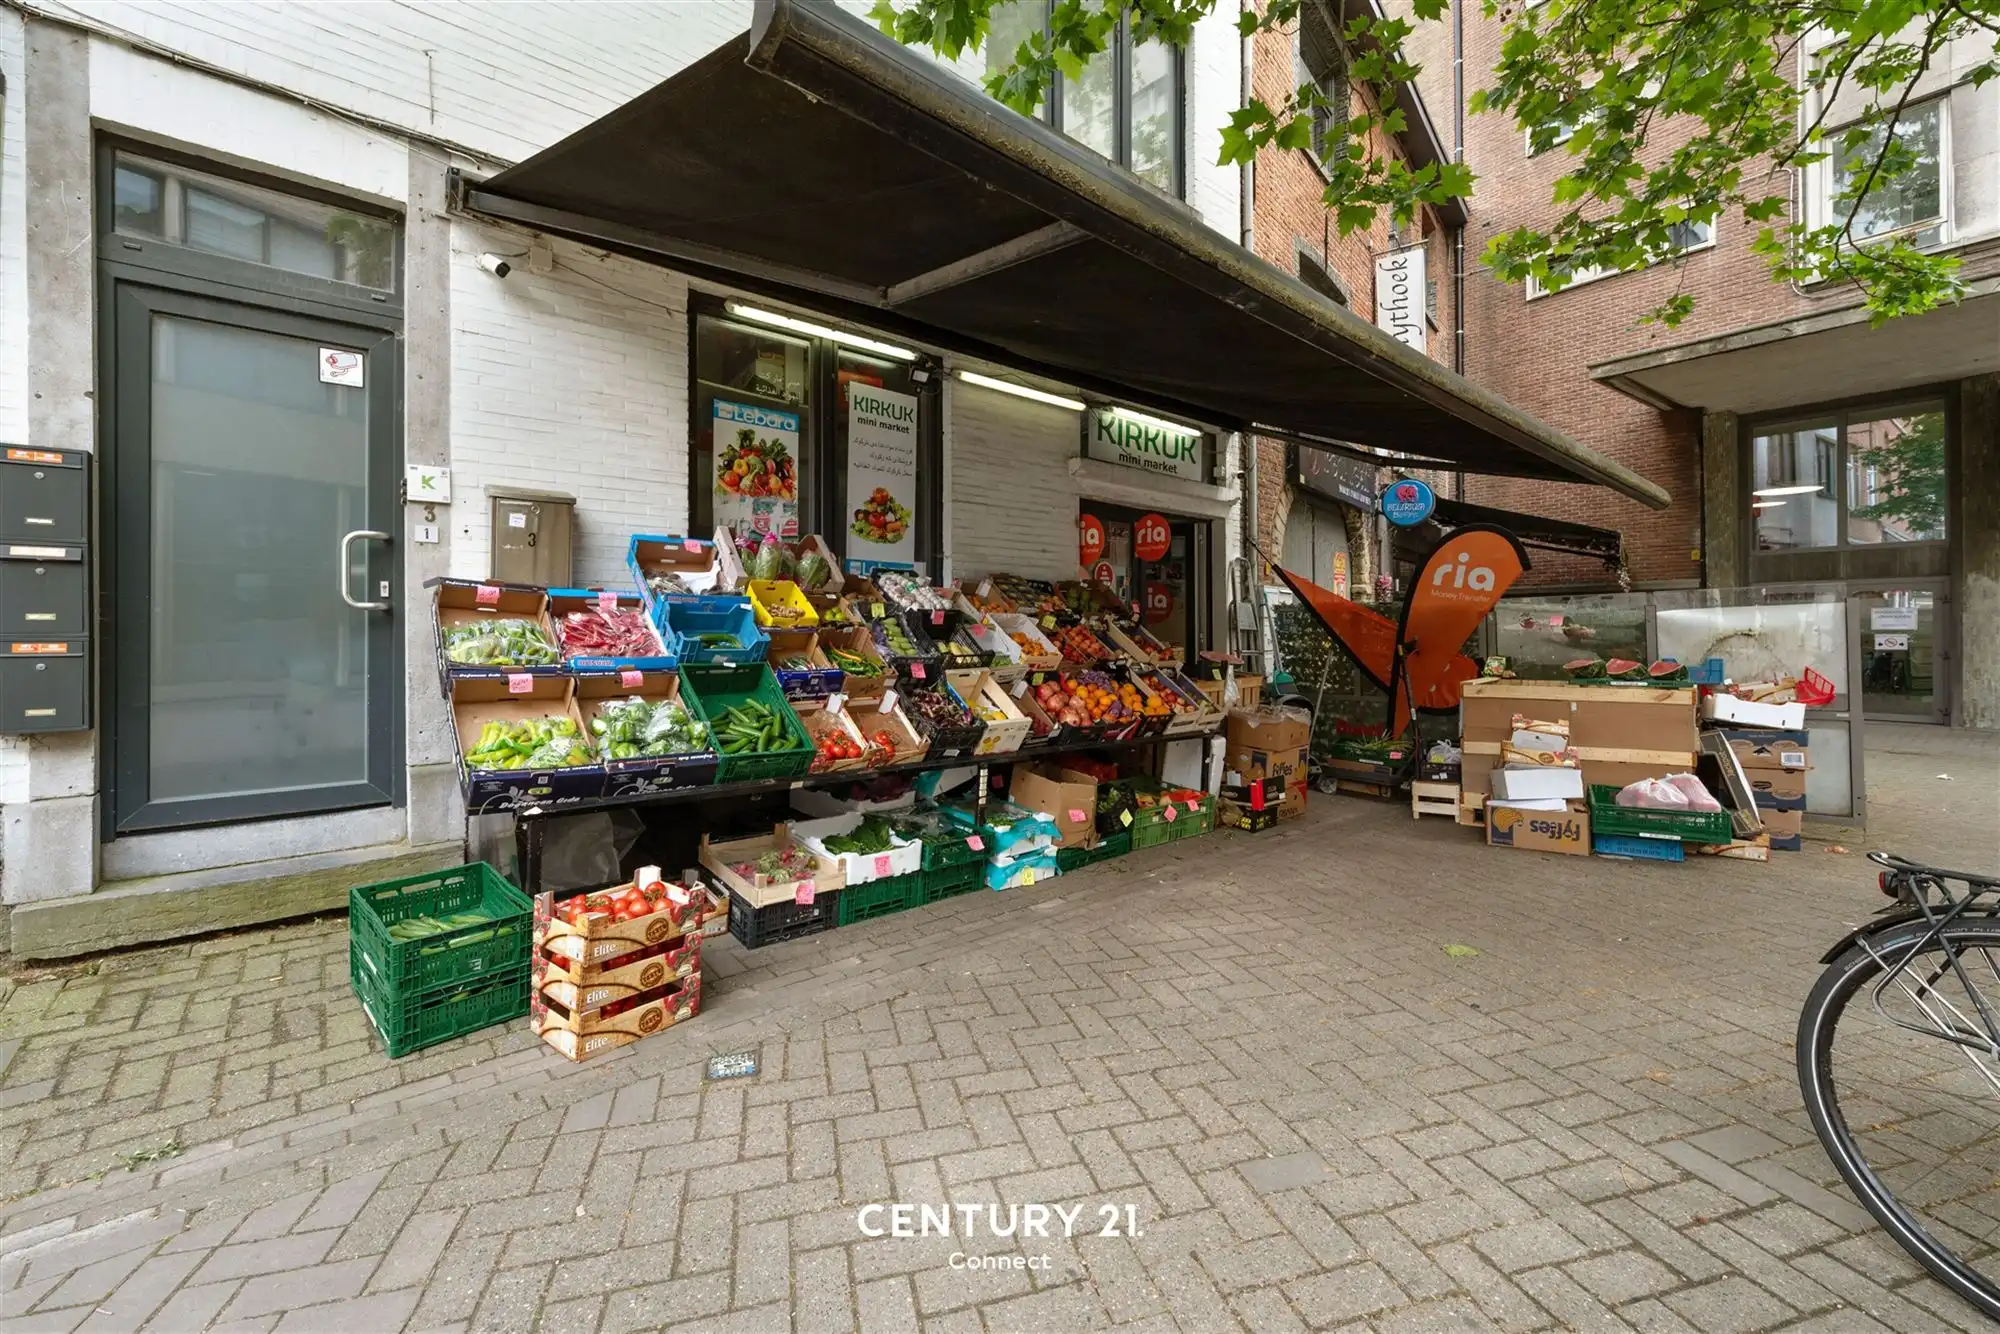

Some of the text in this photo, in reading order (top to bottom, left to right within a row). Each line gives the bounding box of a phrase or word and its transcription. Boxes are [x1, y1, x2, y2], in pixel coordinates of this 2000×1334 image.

[1379, 257, 1423, 344] ythoek
[735, 405, 796, 431] Lebara
[853, 395, 914, 423] KIRKUK
[857, 415, 910, 434] mini market
[1098, 412, 1196, 464] KIRKUK
[1119, 453, 1178, 474] mini market
[424, 505, 436, 522] 3
[424, 528, 429, 540] 1
[528, 532, 536, 547] 3
[1080, 520, 1099, 546] ia
[1137, 519, 1166, 544] ria
[1432, 552, 1495, 592] ria
[1147, 587, 1167, 609] ia
[1529, 819, 1580, 842] Fyffes
[593, 942, 617, 958] Elite
[586, 990, 609, 1004] Elite
[585, 1036, 608, 1052] Elite
